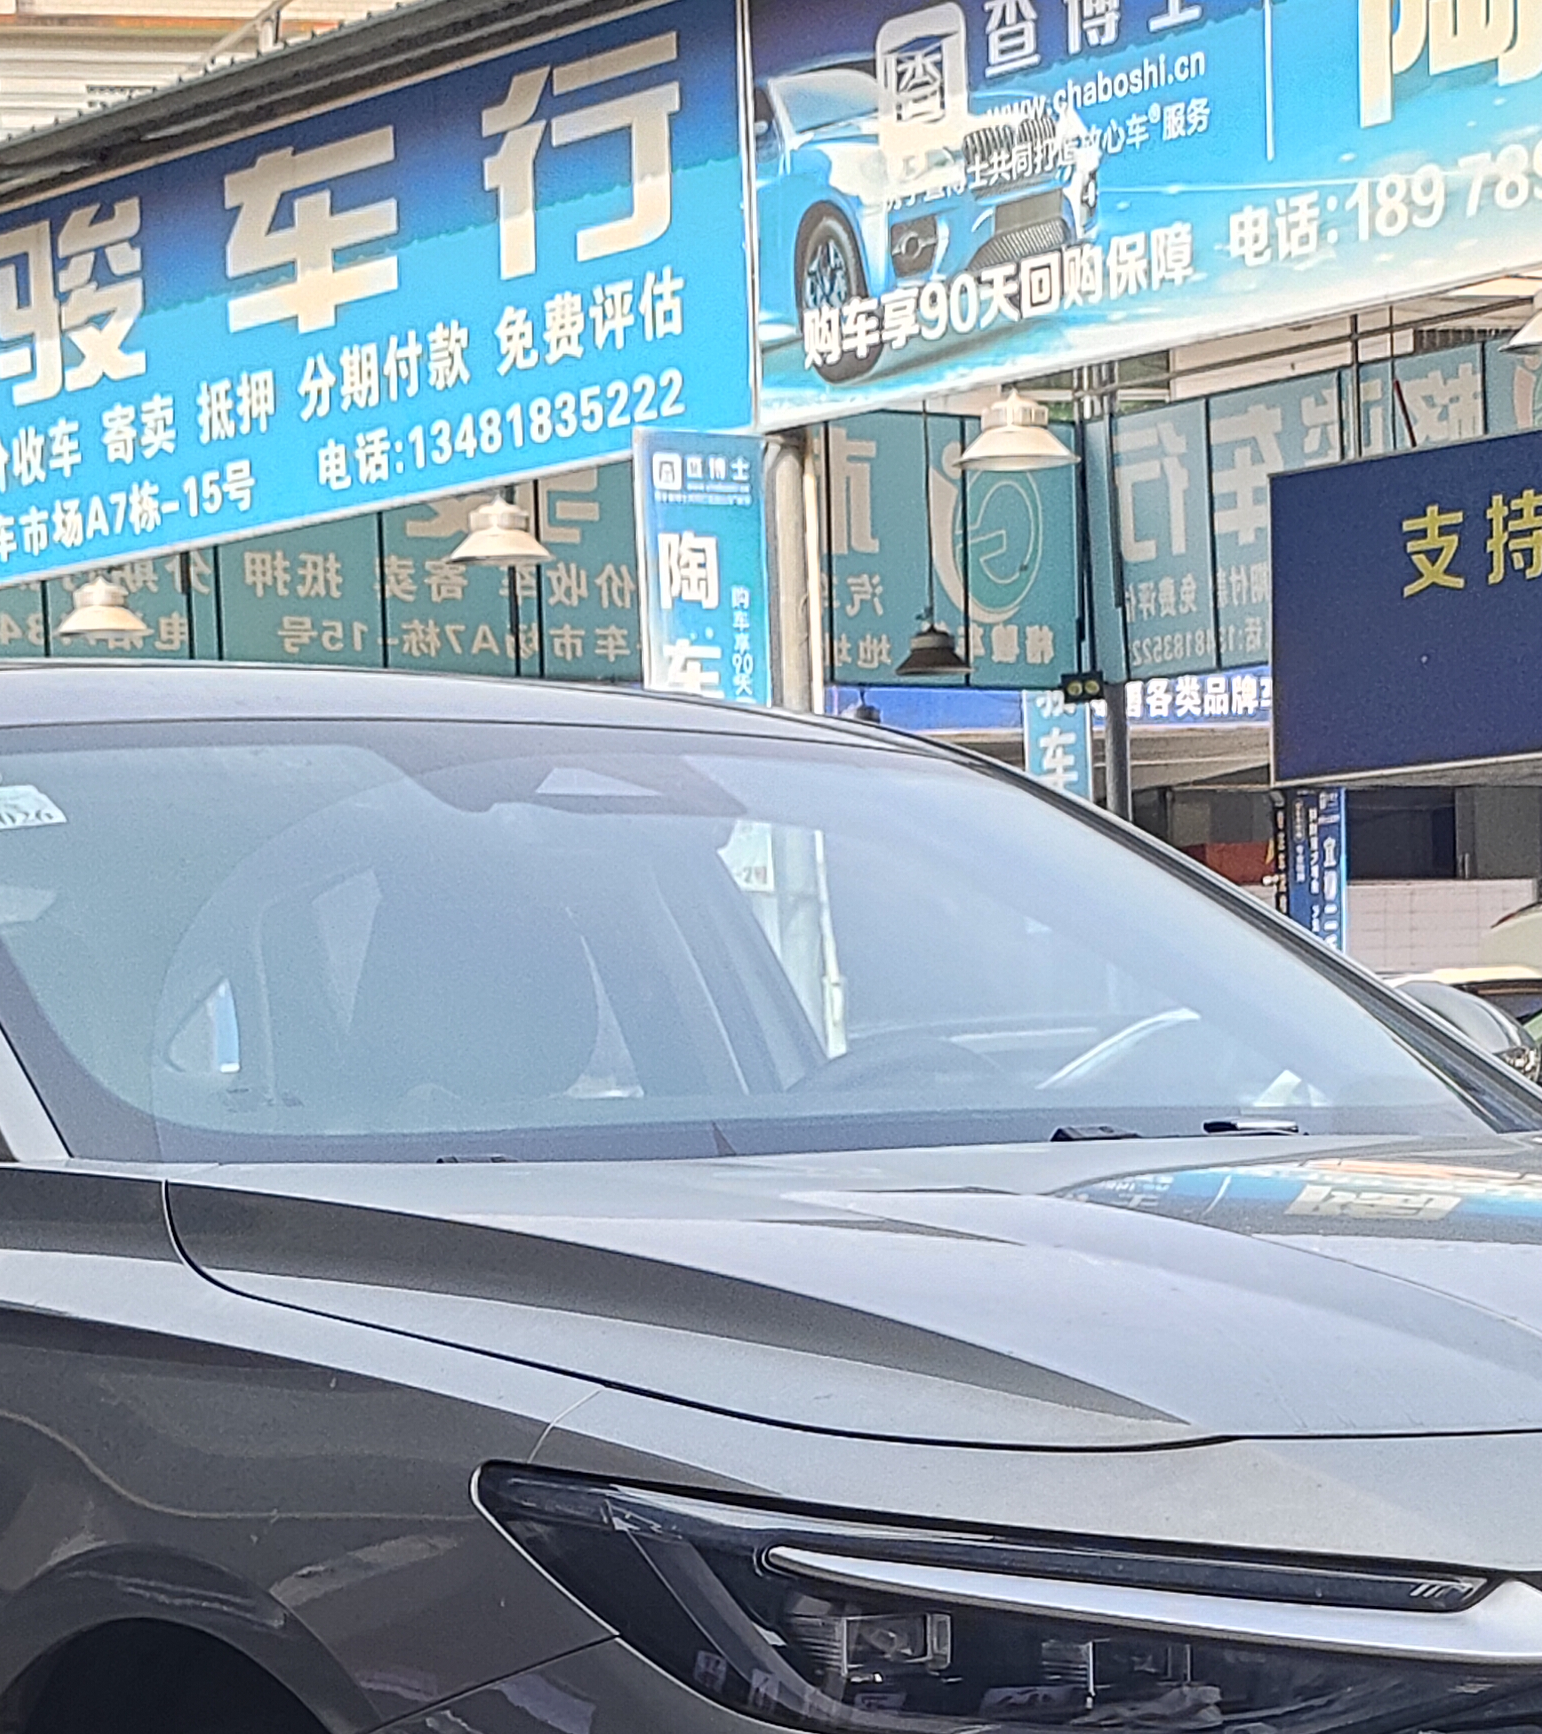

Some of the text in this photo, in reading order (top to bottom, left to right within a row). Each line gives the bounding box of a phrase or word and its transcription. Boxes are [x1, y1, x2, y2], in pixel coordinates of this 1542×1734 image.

[100, 390, 177, 468] 寄卖
[197, 367, 276, 445] 抵押
[297, 320, 472, 423] 分期付款
[494, 266, 687, 378] 免费评估
[802, 221, 1195, 369] 购车享90天回购保障
[317, 367, 687, 493] 电话:13481835222
